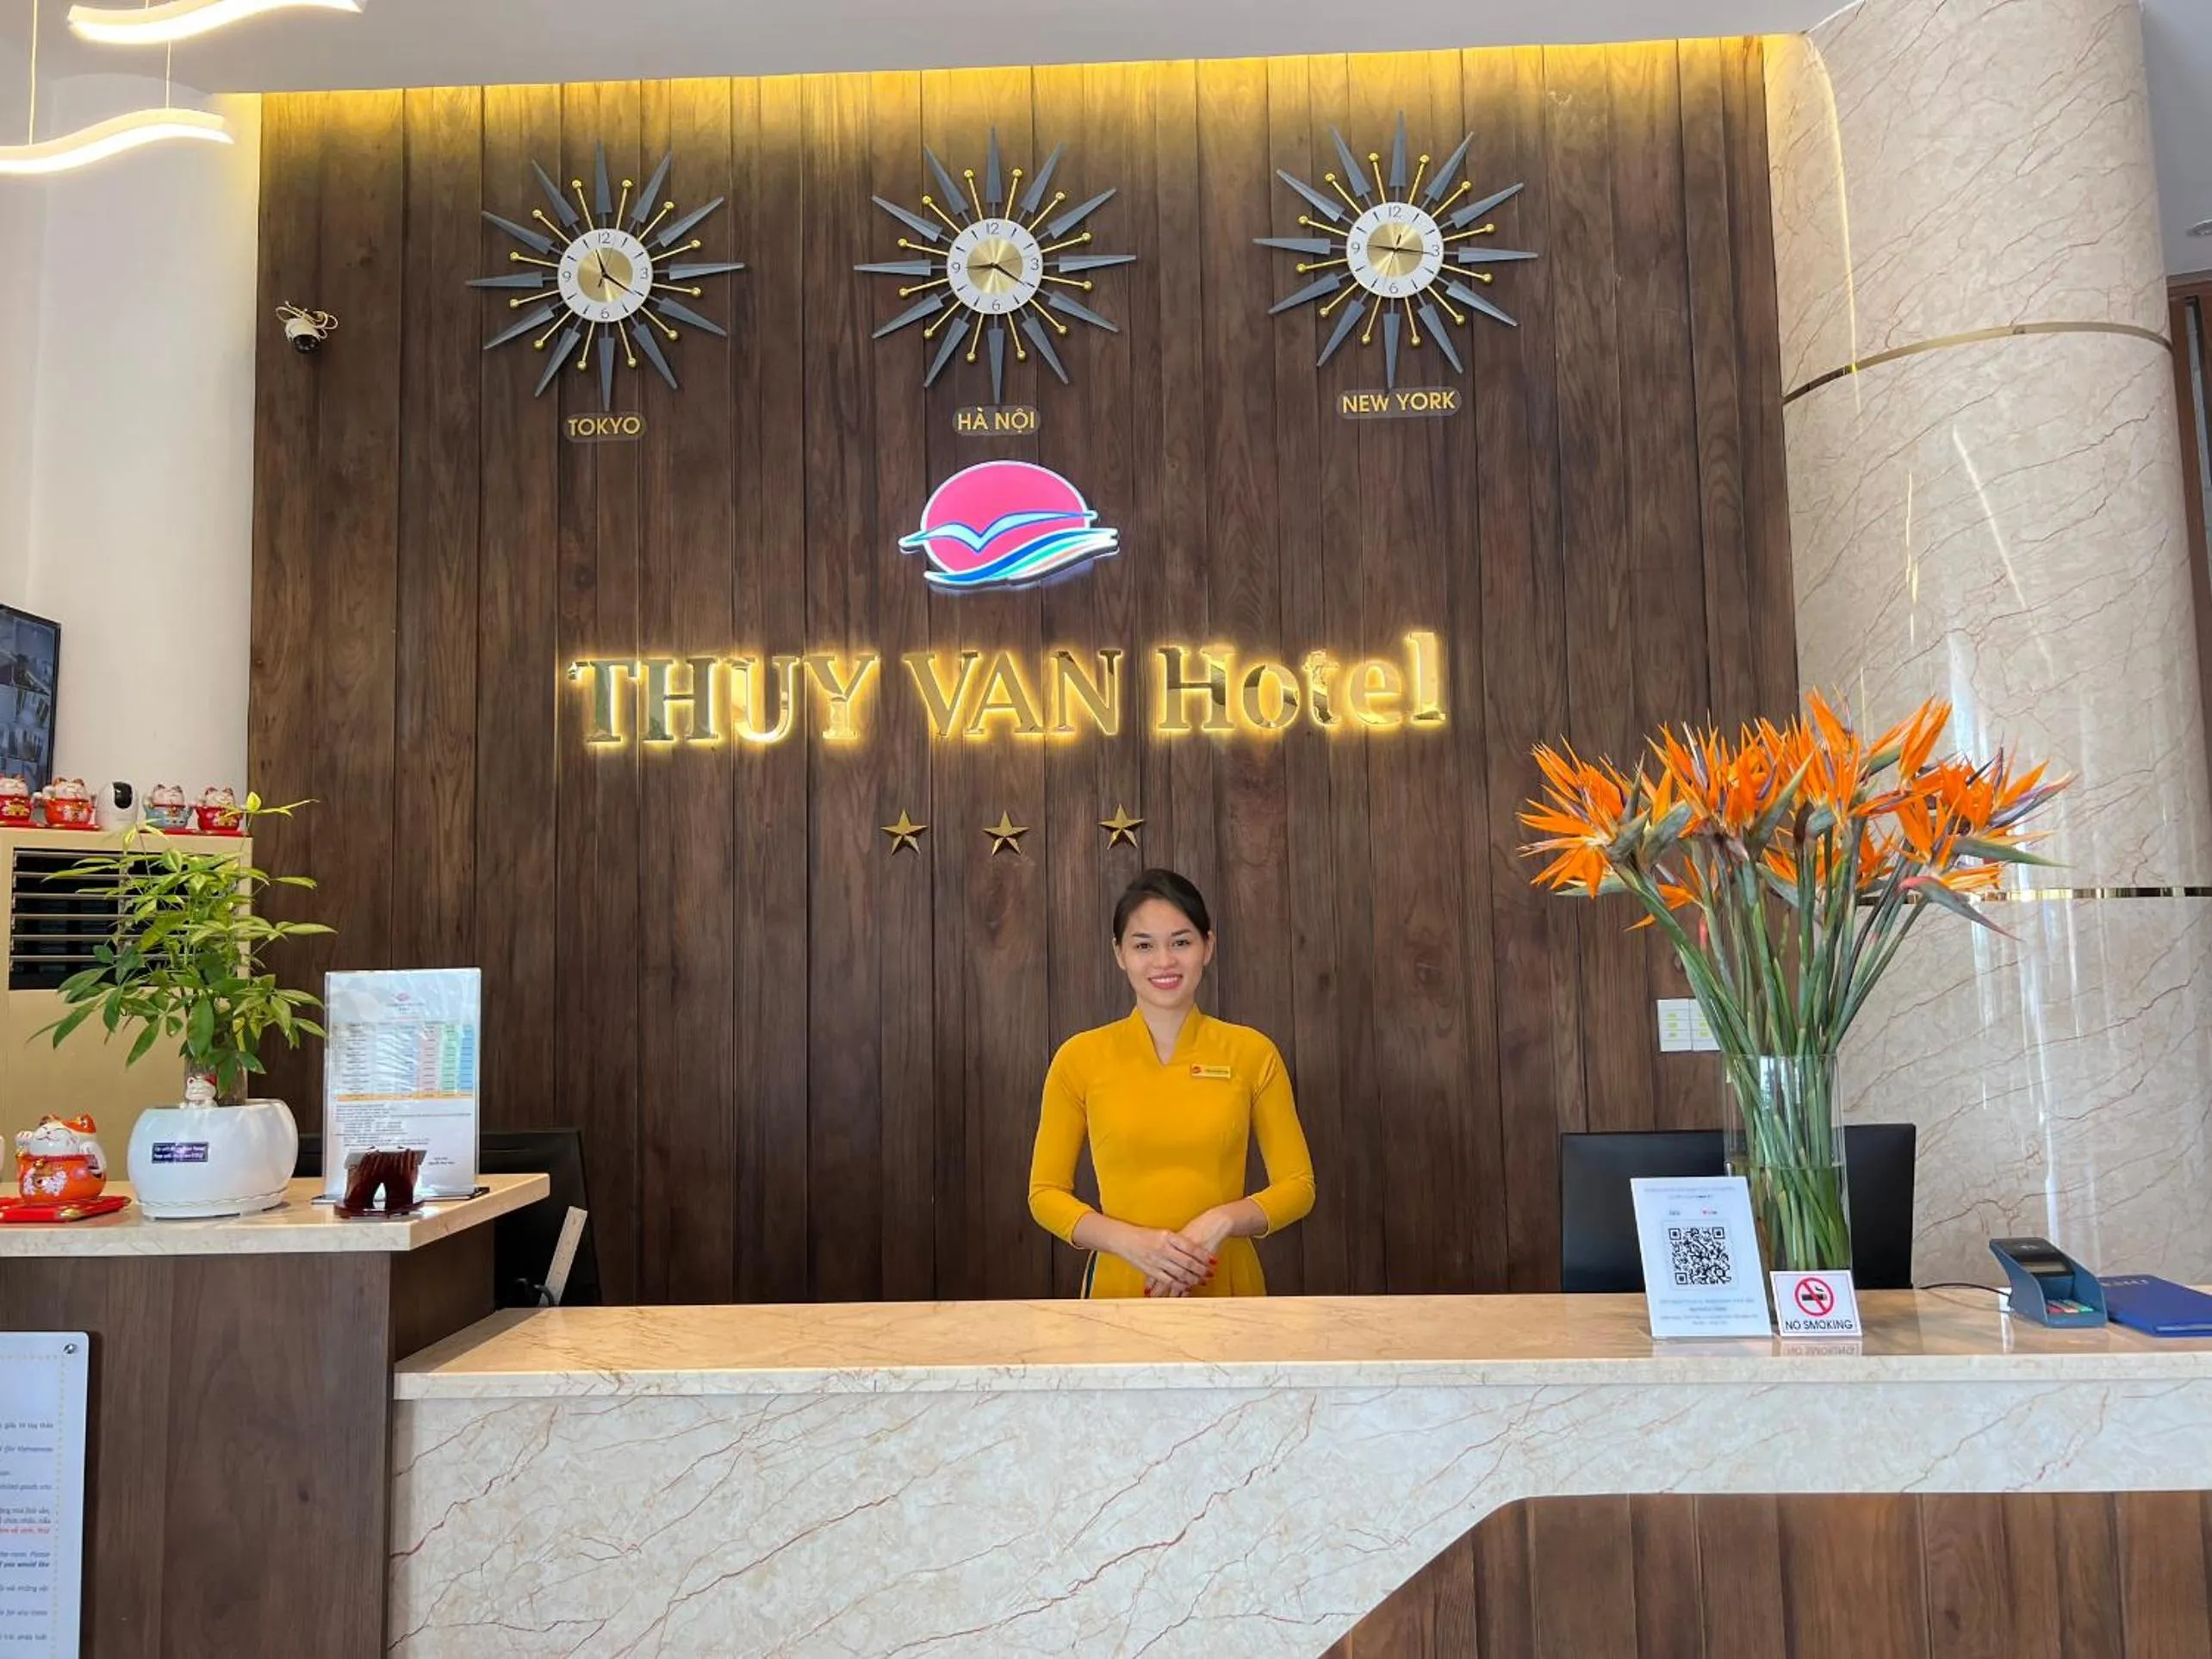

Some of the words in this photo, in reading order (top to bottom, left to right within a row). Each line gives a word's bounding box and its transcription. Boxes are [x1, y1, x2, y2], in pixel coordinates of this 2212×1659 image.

[1388, 206, 1402, 218] 12
[985, 222, 1000, 235] 12
[598, 231, 611, 245] 12
[1351, 242, 1361, 255] 9
[1430, 244, 1440, 258] 3
[951, 262, 961, 274] 9
[1029, 258, 1040, 270] 3
[562, 270, 572, 283] 9
[639, 267, 649, 280] 3
[1389, 283, 1399, 295] 6
[991, 299, 1001, 311] 6
[600, 307, 610, 320] 6
[1342, 394, 1389, 413] NEW
[1395, 390, 1456, 411] YORK
[957, 406, 989, 431] HÀ
[995, 407, 1035, 433] NỘI
[568, 416, 641, 437] TOKYO
[567, 652, 880, 744] THUY
[902, 649, 1123, 737] VAN
[1156, 631, 1447, 731] Hotel
[1785, 1320, 1801, 1331] NO
[1803, 1319, 1854, 1330] SMOKING
